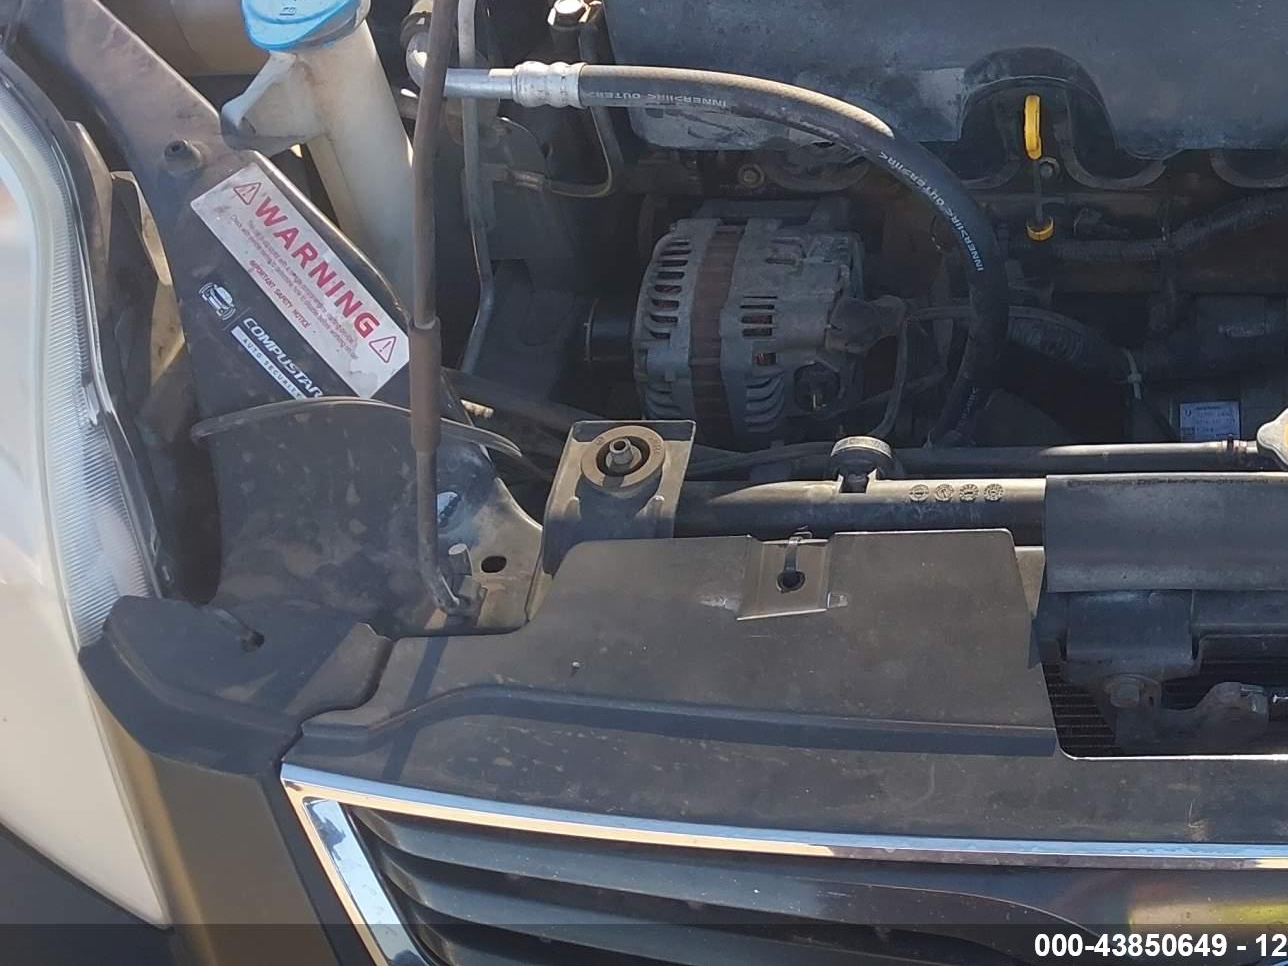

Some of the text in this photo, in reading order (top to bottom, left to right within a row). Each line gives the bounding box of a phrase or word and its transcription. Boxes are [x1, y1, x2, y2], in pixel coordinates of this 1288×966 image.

[247, 258, 276, 289] PORTANT
[257, 196, 381, 339] WARNING
[242, 337, 262, 358] AUTO
[243, 318, 323, 397] COMPUSTAR
